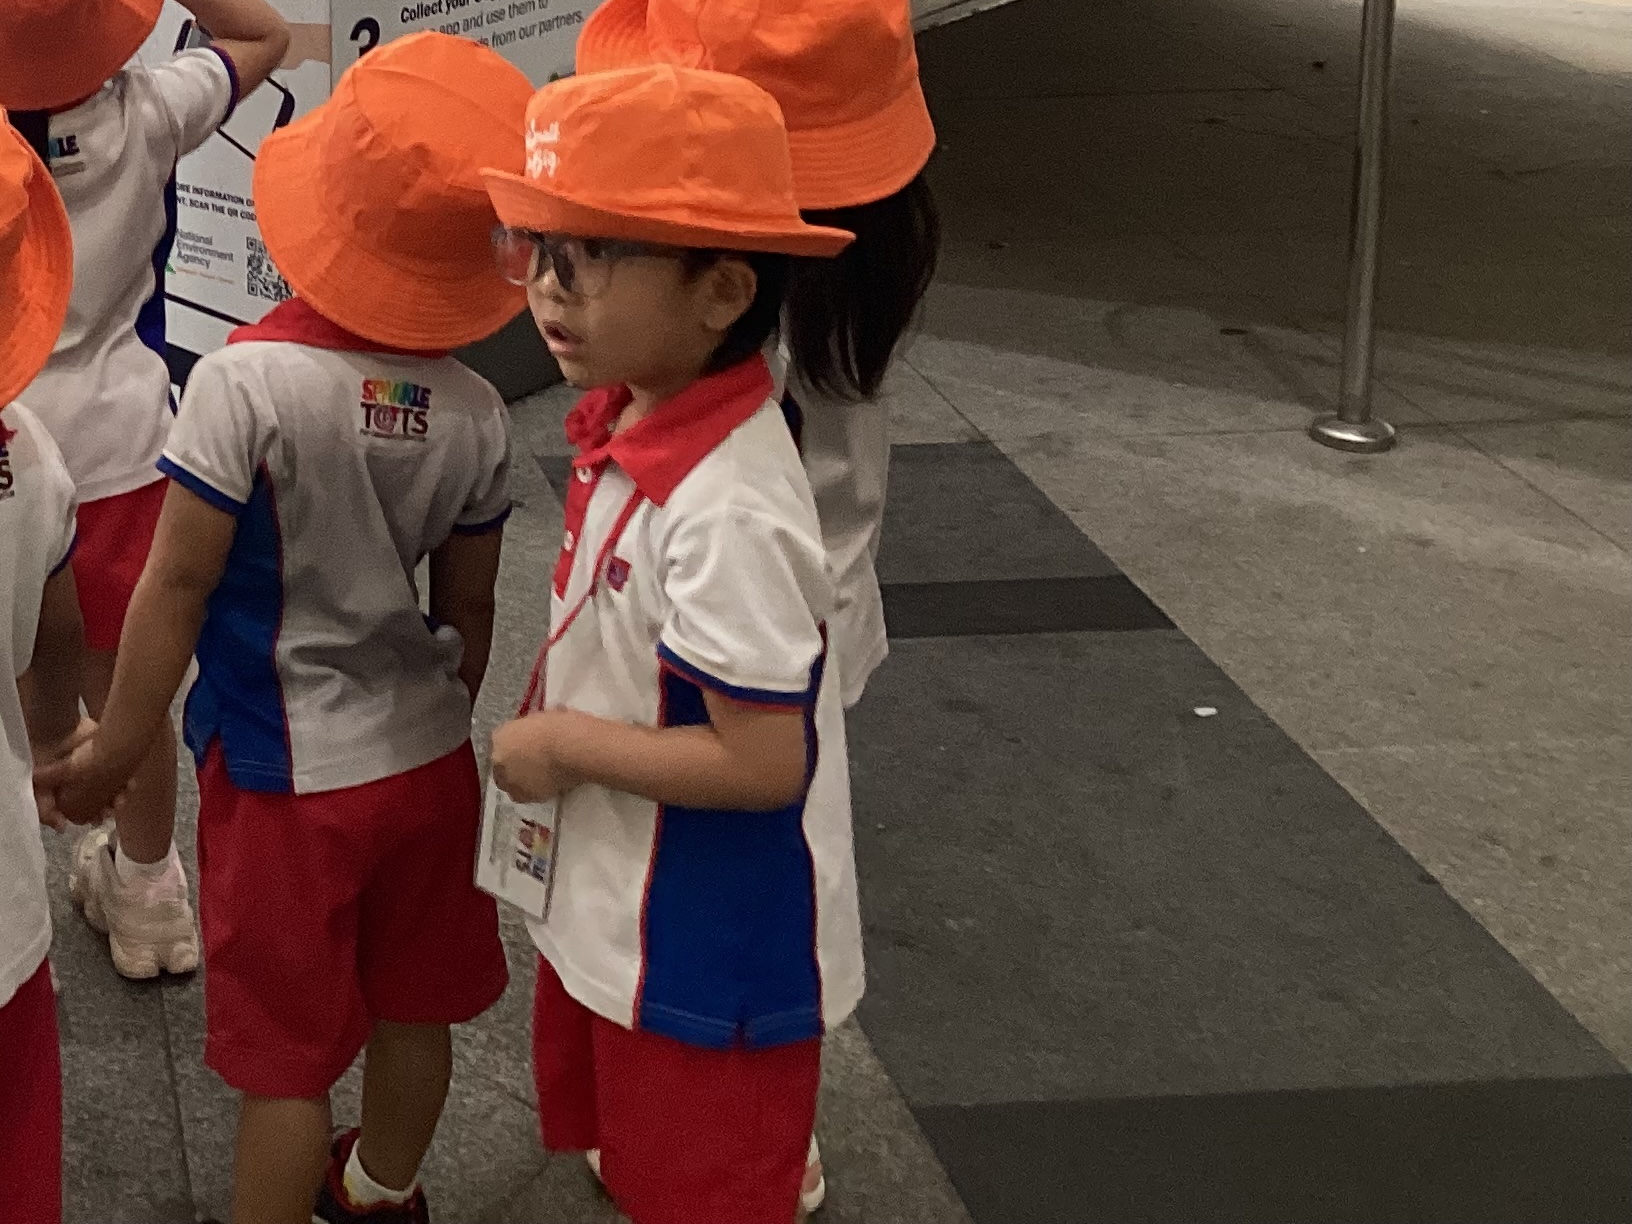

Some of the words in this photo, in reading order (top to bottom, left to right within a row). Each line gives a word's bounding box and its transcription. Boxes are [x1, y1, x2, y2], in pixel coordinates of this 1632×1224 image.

[462, 14, 484, 32] and
[486, 8, 506, 25] use
[491, 30, 517, 49] from
[519, 24, 536, 41] our
[192, 185, 244, 205] INFORMATION
[189, 199, 209, 211] SCAN
[211, 203, 225, 214] THE
[227, 207, 238, 217] QR
[176, 239, 234, 262] Environment
[177, 250, 211, 269] Agency
